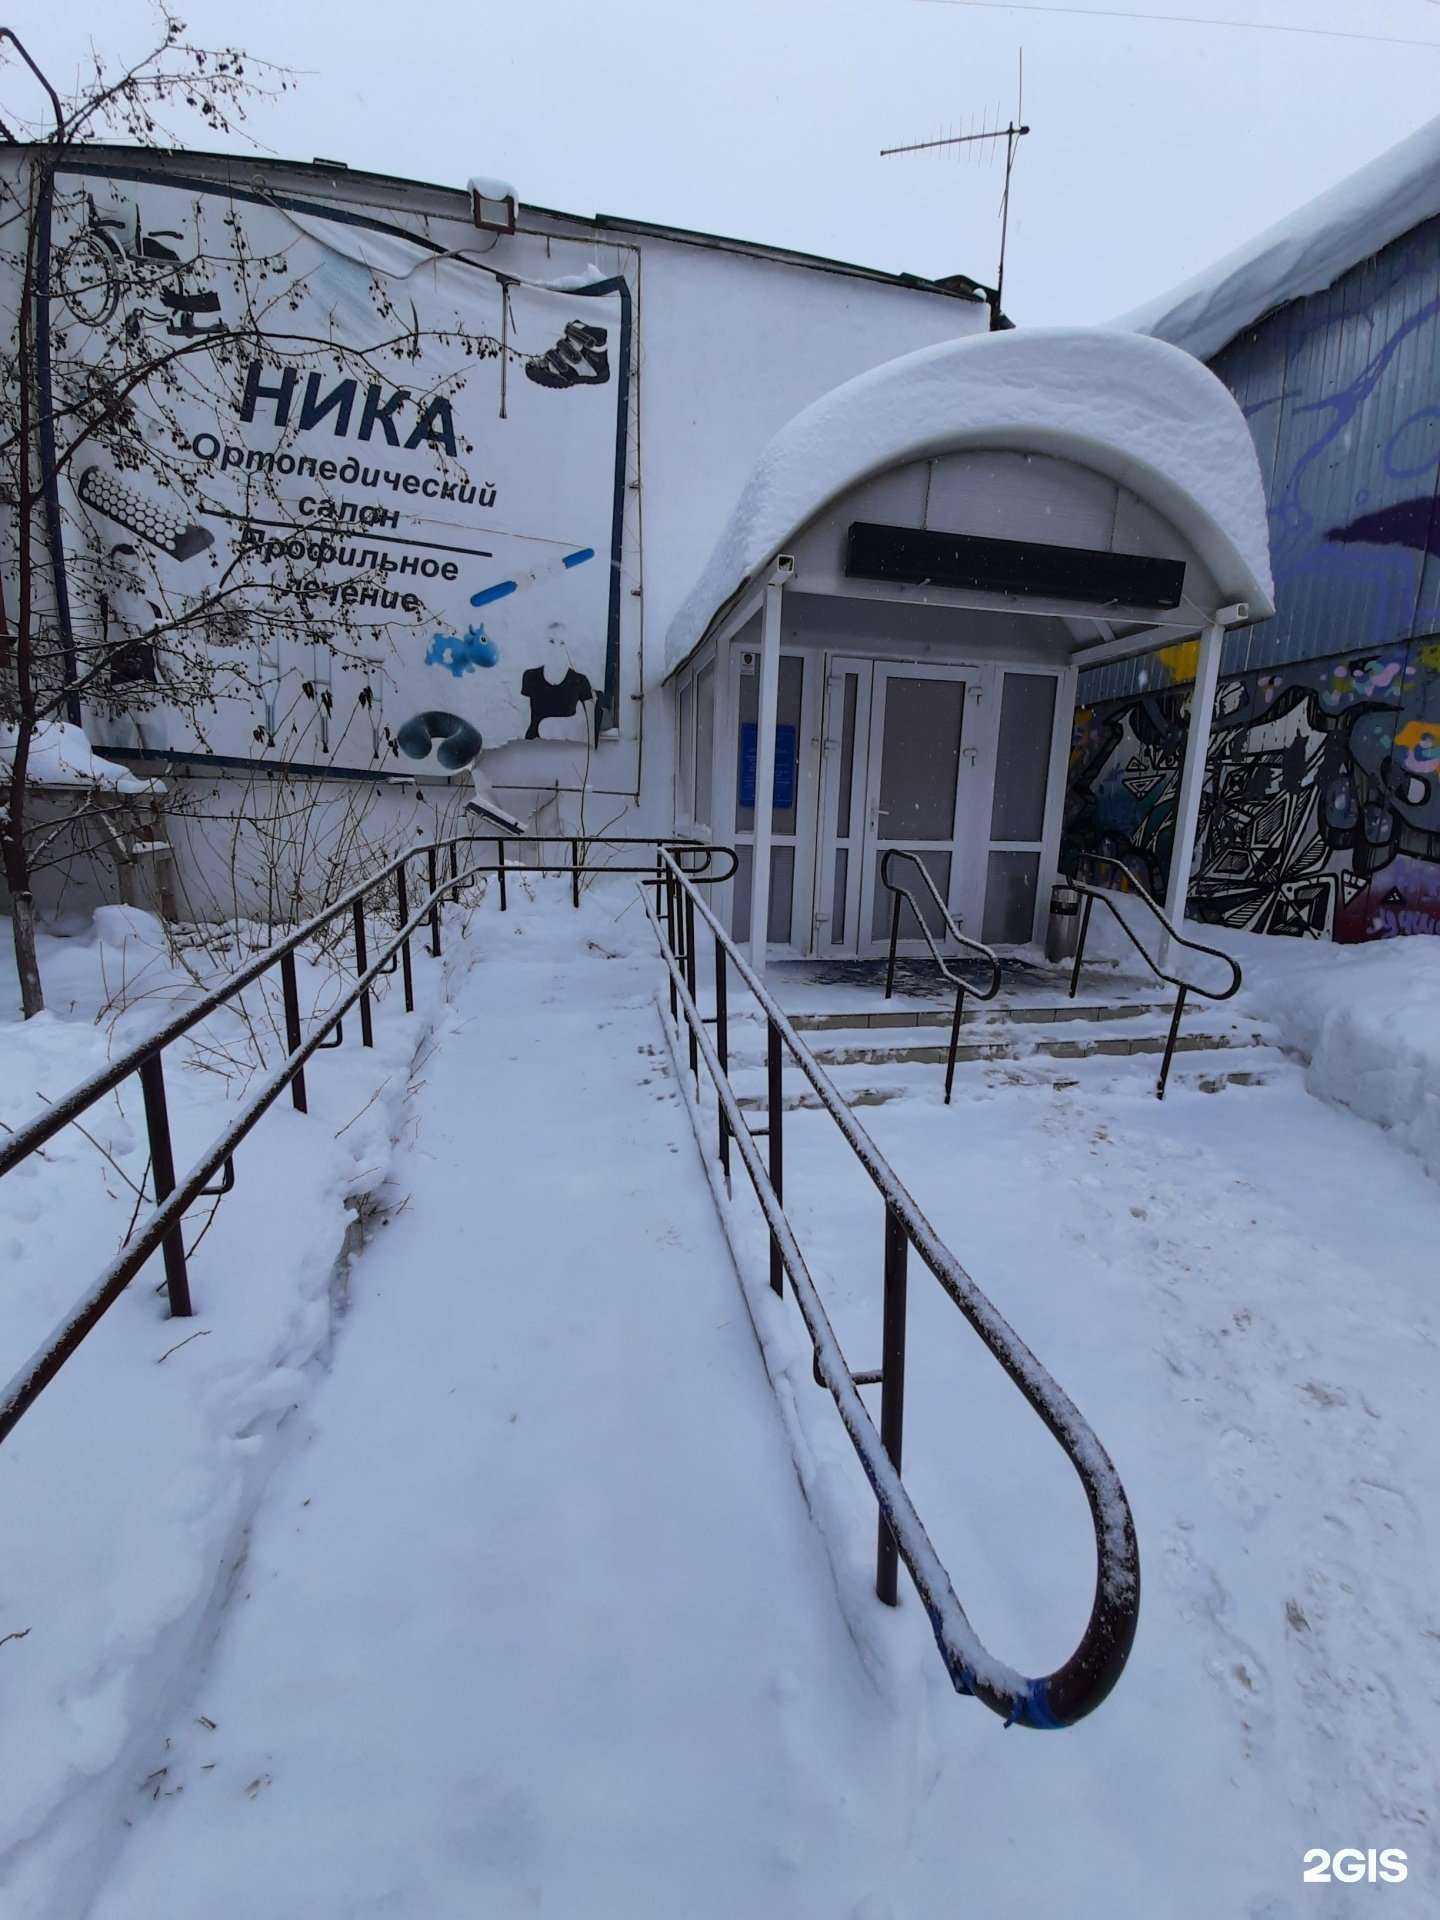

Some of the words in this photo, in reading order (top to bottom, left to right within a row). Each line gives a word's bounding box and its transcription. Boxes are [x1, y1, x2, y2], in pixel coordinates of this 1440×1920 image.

[239, 361, 458, 457] НИКА
[192, 432, 498, 508] Ортопедический
[298, 495, 400, 528] салон
[241, 527, 459, 581] Профильное
